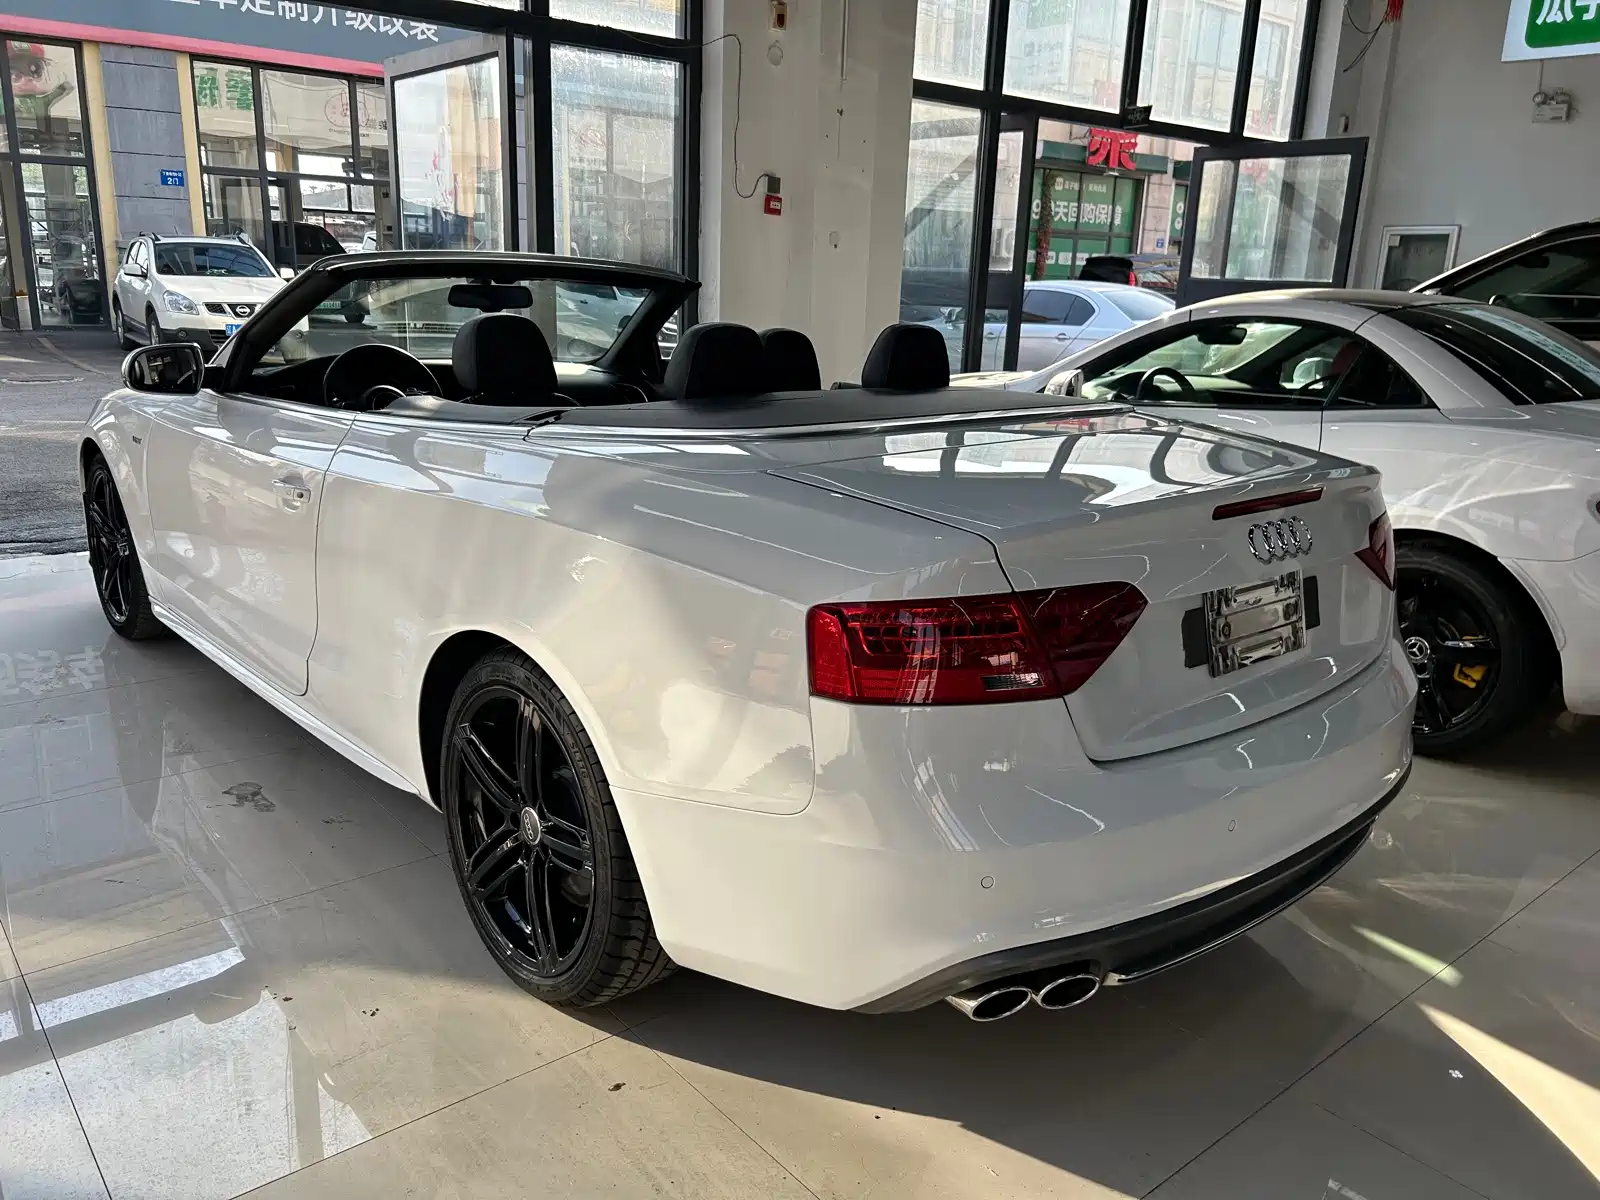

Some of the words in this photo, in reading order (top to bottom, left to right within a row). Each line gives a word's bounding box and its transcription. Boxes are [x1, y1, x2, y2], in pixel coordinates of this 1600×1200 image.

[1032, 199, 1122, 226] 9天回购保障
